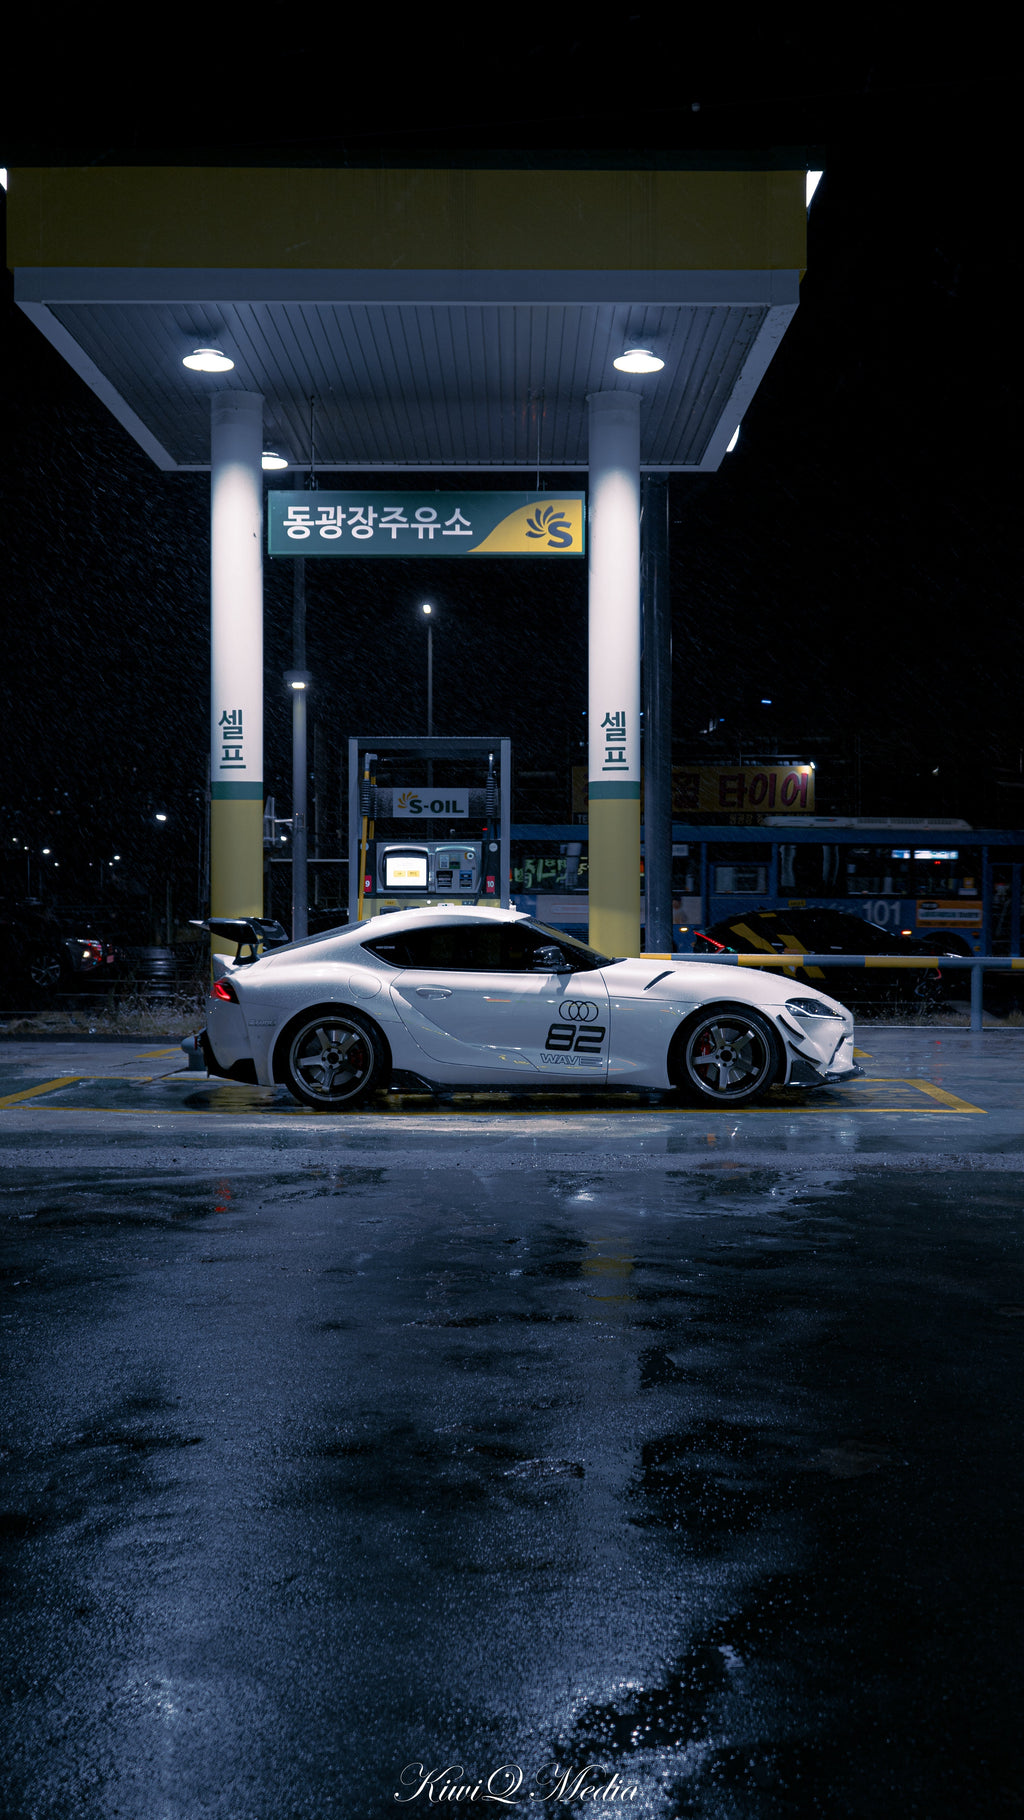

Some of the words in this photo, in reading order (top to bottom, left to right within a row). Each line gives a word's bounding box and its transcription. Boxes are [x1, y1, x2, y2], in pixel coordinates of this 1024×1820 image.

[283, 505, 473, 540] 동광장주유소
[218, 709, 246, 769] 셀프
[600, 711, 629, 771] 셀프
[719, 772, 808, 808] 타이어
[409, 799, 464, 814] S-OIL
[487, 880, 495, 888] 10
[862, 900, 901, 926] 101
[545, 1023, 606, 1054] 82
[540, 1053, 603, 1068] WAVE
